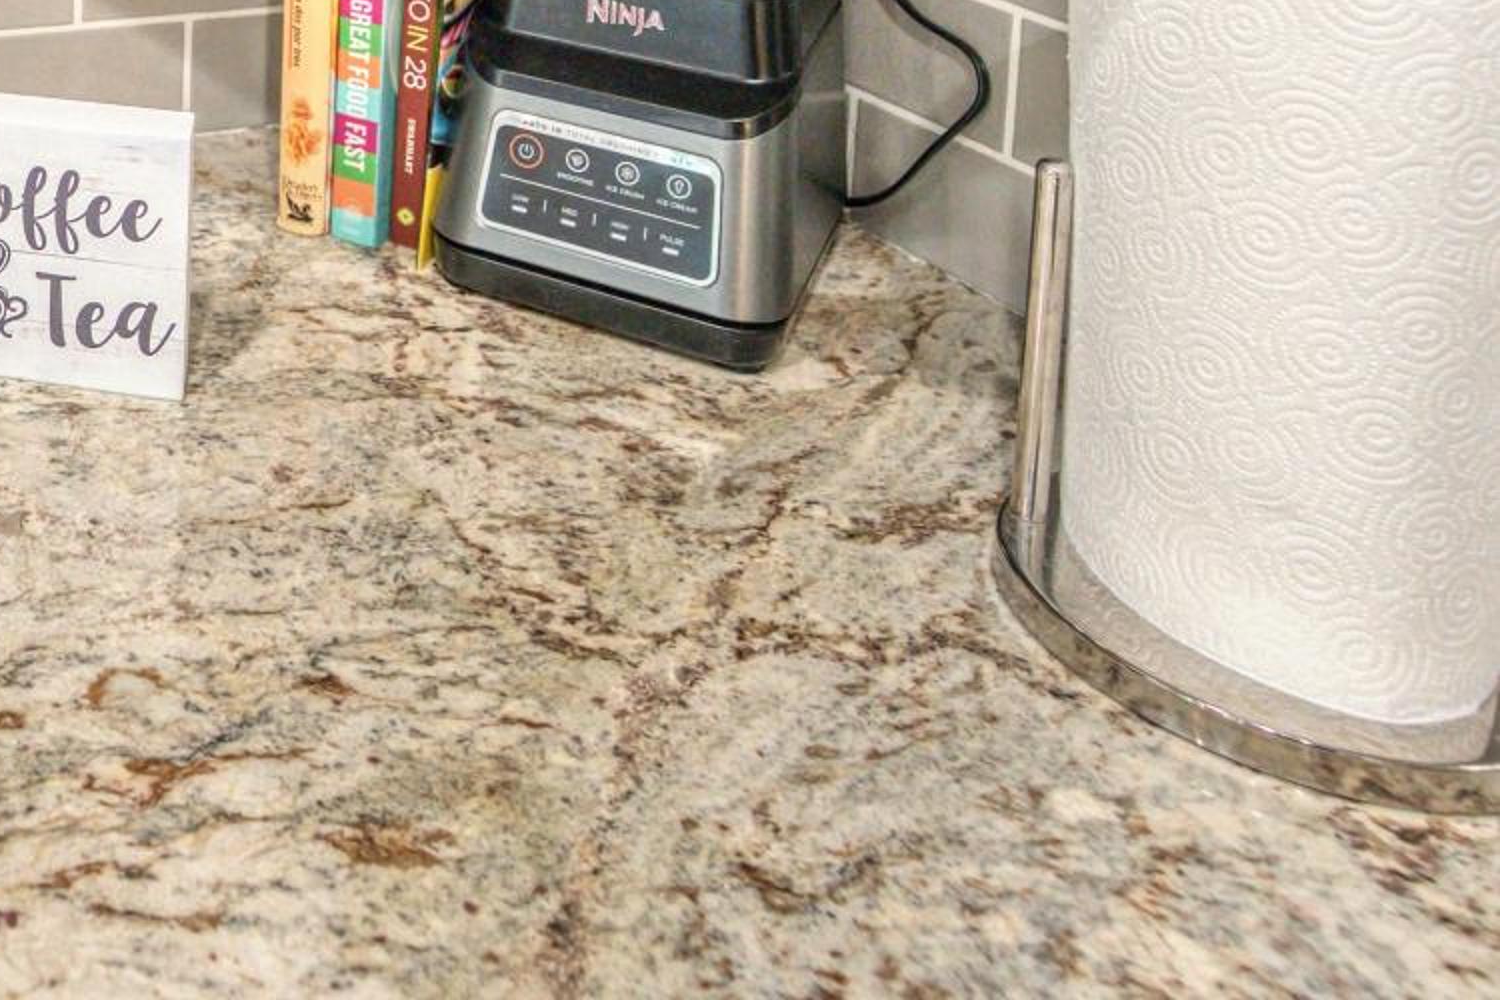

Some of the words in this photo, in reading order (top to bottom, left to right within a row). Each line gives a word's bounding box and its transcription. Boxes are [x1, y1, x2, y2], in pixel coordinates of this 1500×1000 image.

[407, 24, 429, 53] IN
[345, 67, 369, 120] FOOD
[403, 55, 427, 91] 28
[342, 122, 366, 172] FAST
[35, 271, 177, 357] Tea
